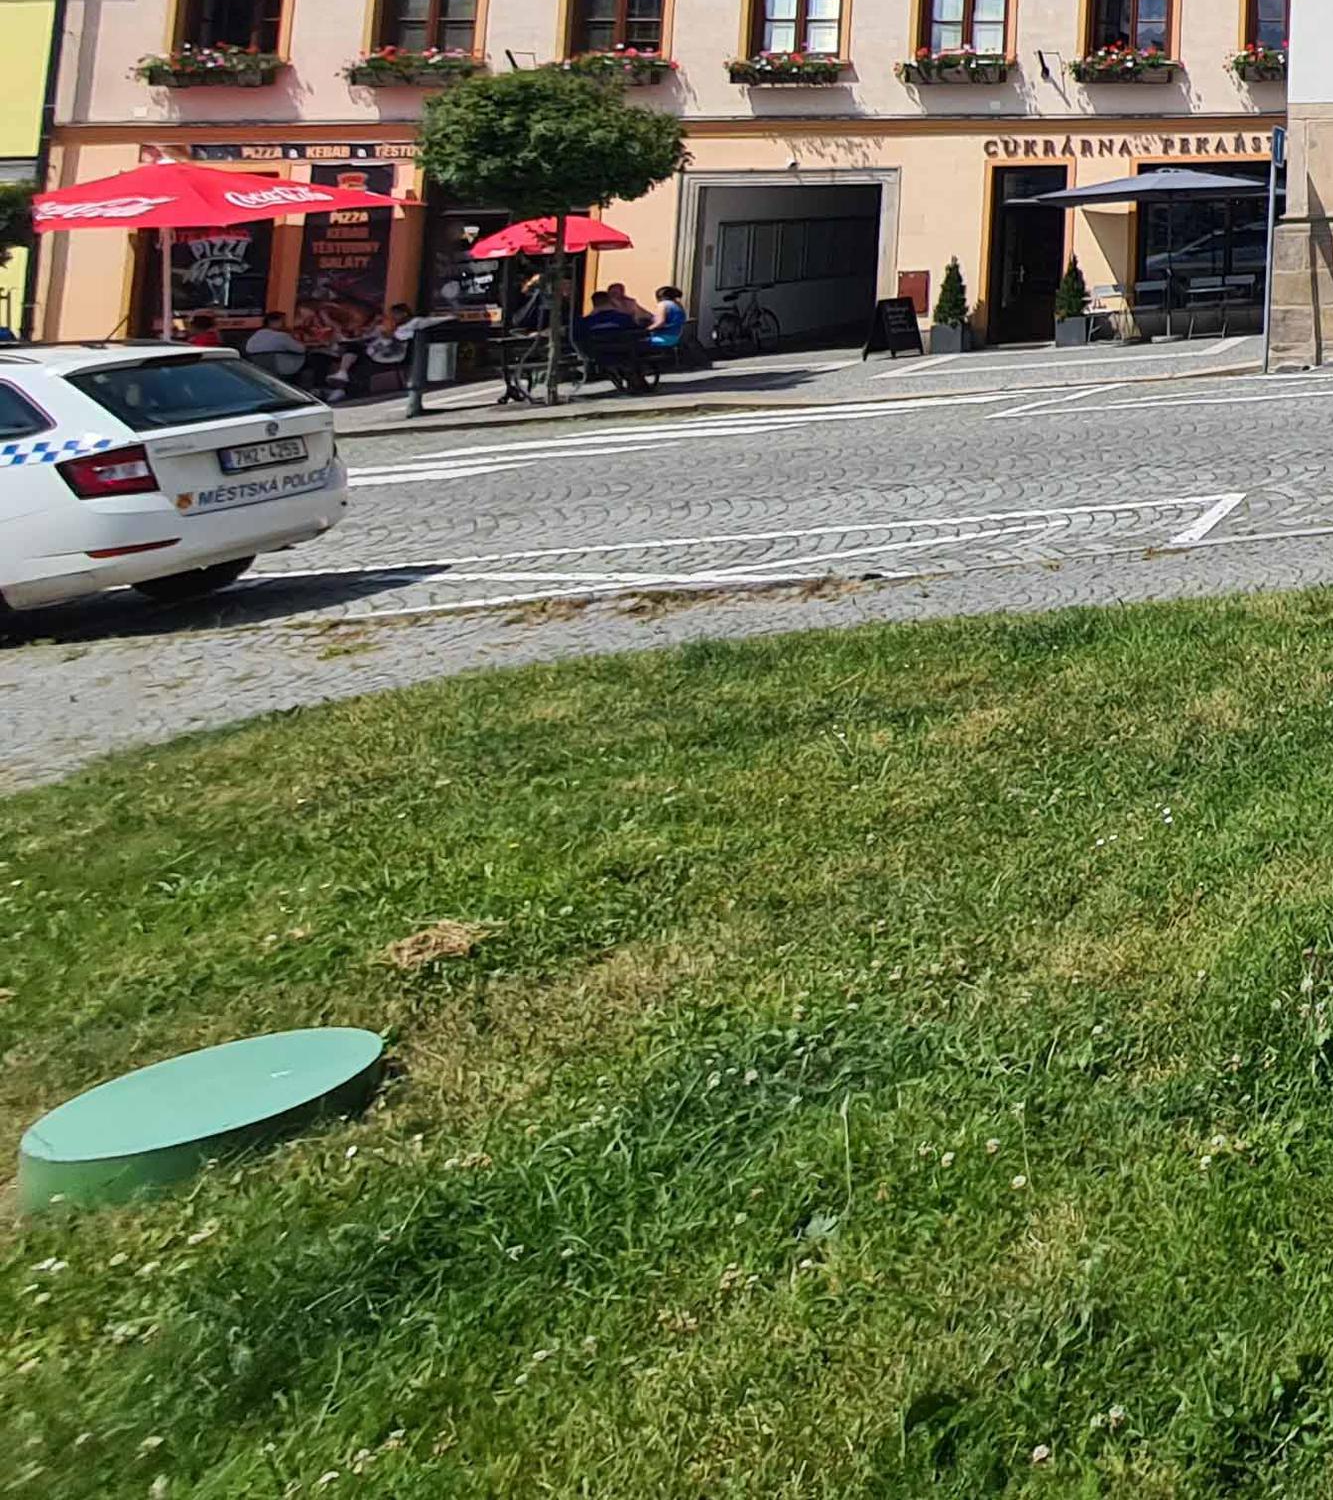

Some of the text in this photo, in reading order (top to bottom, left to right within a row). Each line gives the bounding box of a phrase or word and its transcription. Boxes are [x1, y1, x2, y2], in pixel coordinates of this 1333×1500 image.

[241, 146, 282, 158] PIZZA
[305, 145, 350, 158] KEBAB
[983, 135, 1132, 158] CUKRÁRNA
[329, 211, 370, 224] PIZZA
[188, 238, 252, 260] PIZZA
[198, 467, 331, 506] MĚSTSKÁ POLICE
